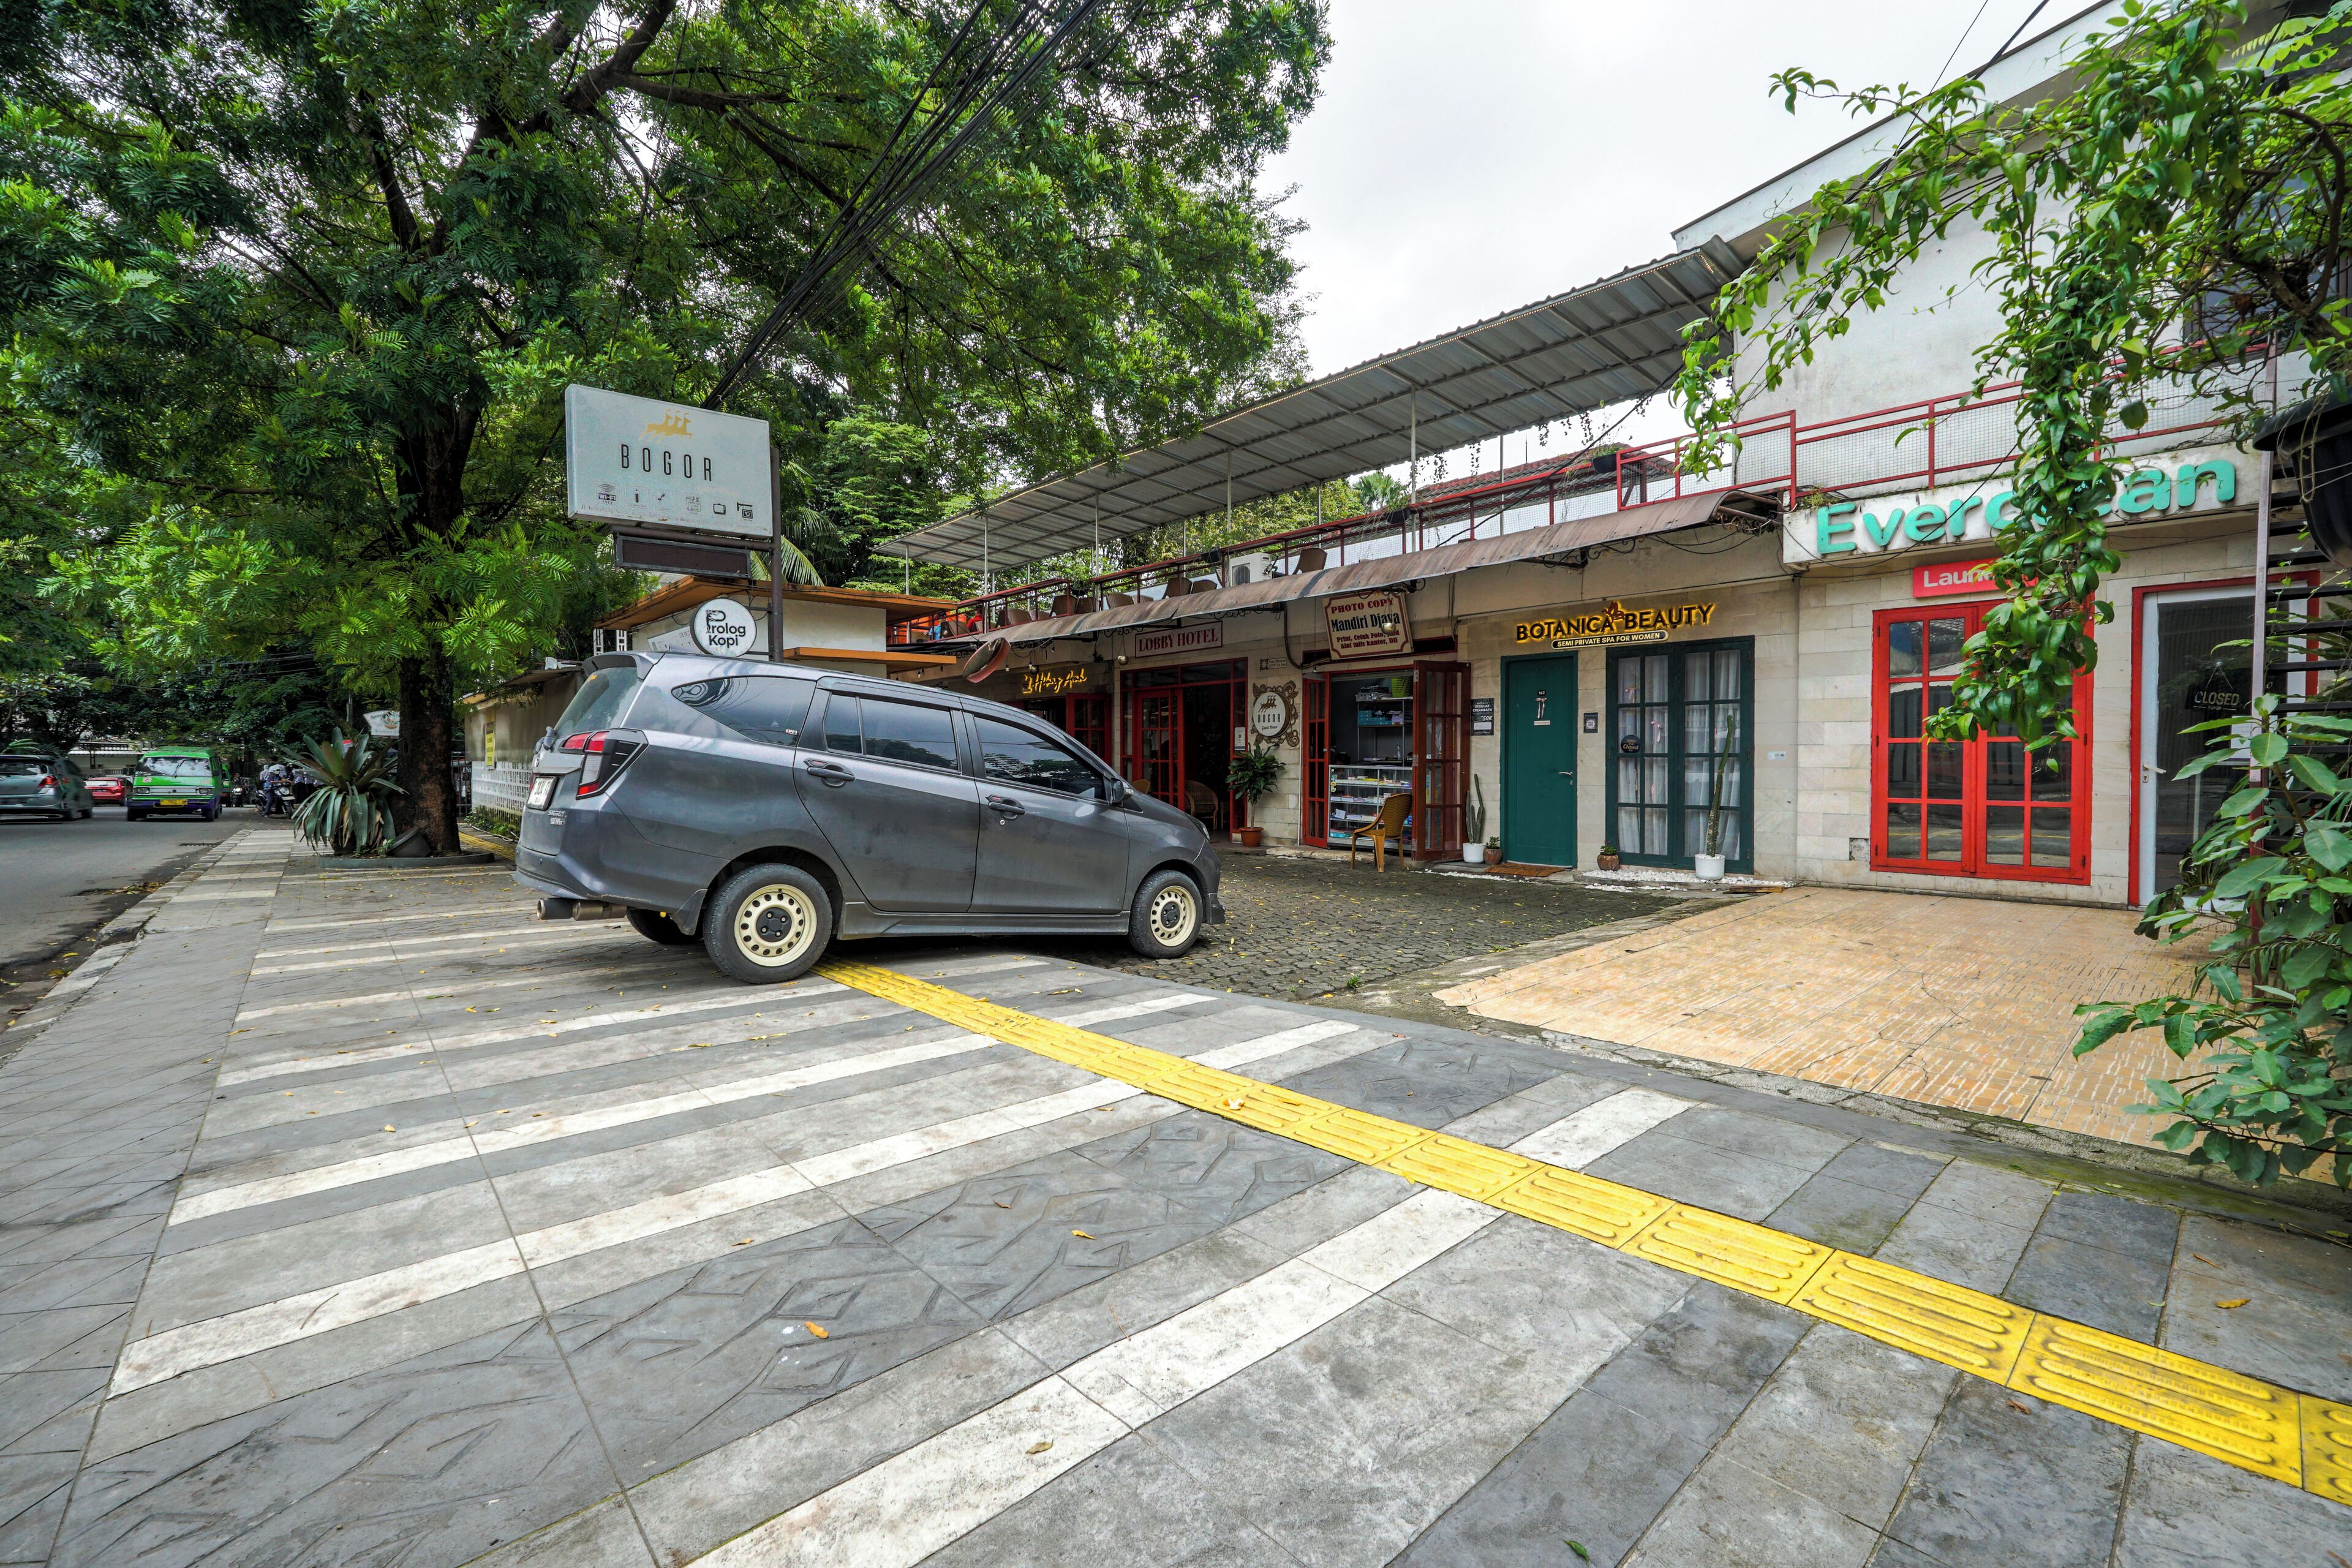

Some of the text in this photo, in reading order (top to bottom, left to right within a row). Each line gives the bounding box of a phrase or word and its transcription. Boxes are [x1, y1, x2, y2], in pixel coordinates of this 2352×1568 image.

[621, 443, 712, 481] BOGOR
[1331, 598, 1393, 614] PHOTO COPY
[706, 609, 746, 637] Prolog
[1331, 612, 1400, 632] Mandiri Djaya
[1516, 603, 1714, 641] BOTANICA BEAUTY
[709, 635, 739, 649] Kopi
[1139, 628, 1218, 652] LOBBY HOTEL
[1631, 633, 1660, 641] WOMEN
[2195, 691, 2240, 706] CLOSED
[1257, 714, 1280, 723] BOGOR
